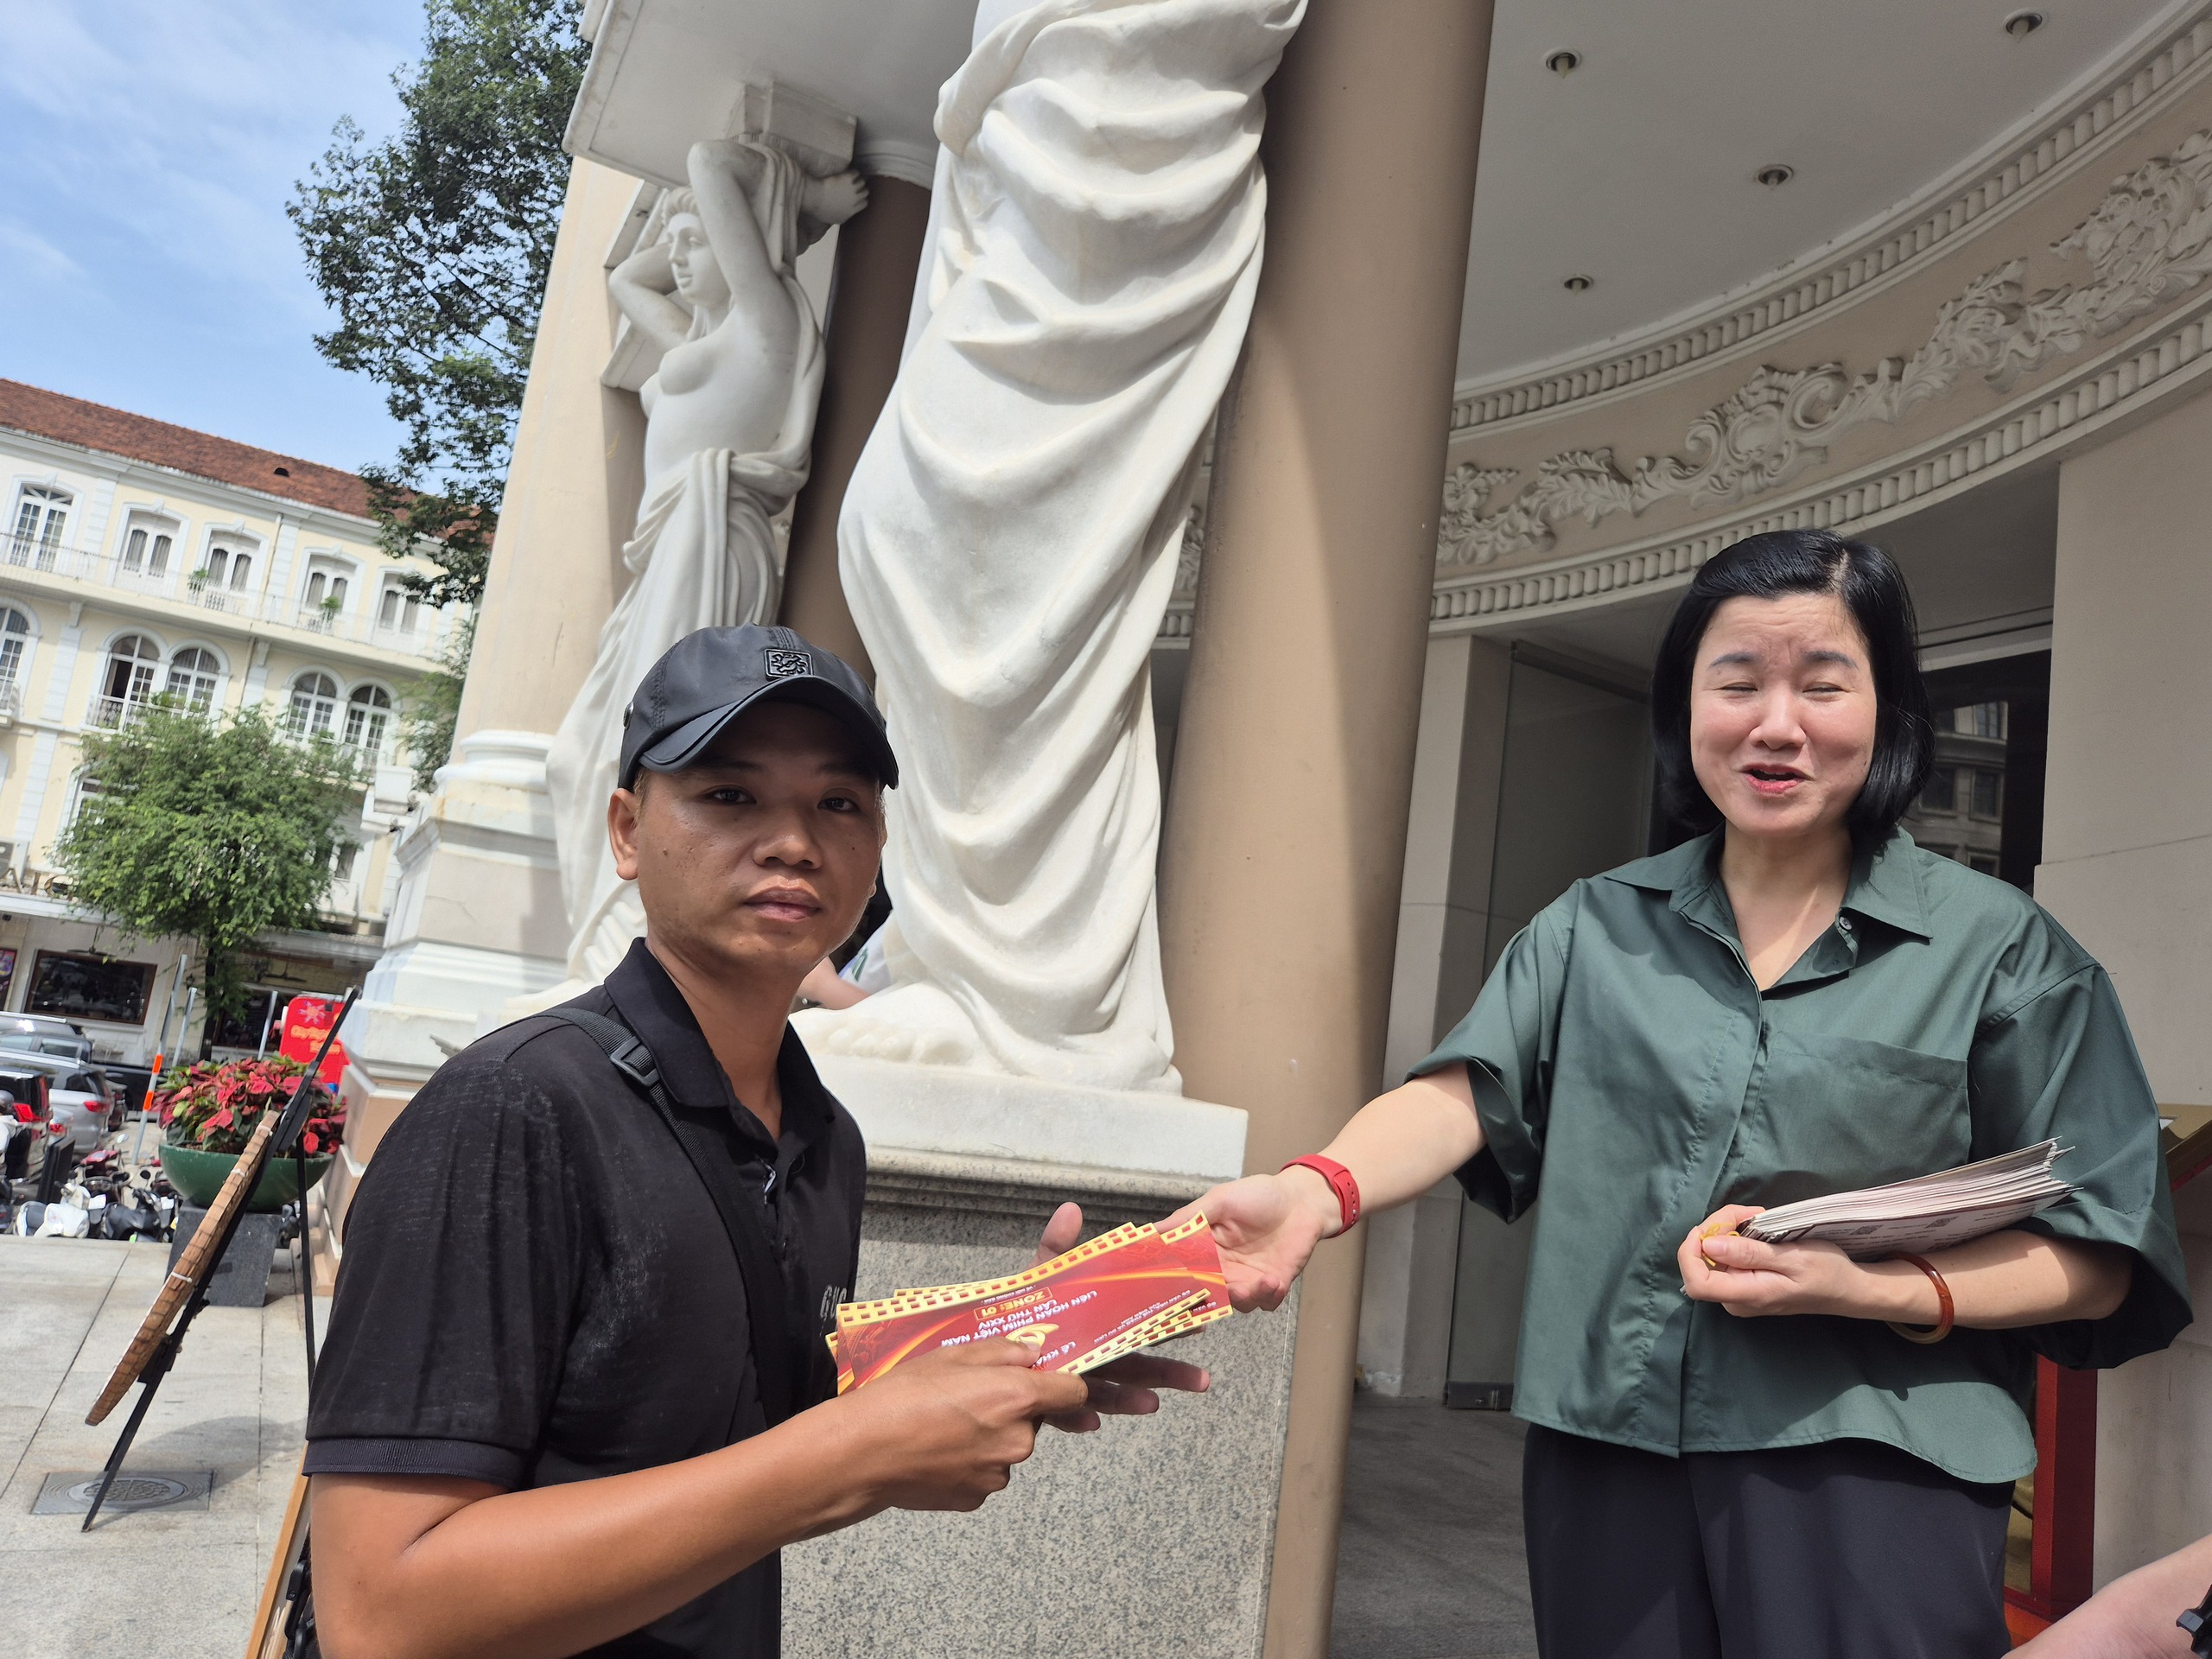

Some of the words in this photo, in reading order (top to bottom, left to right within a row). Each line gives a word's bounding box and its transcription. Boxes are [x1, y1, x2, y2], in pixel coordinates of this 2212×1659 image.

[1071, 1290, 1098, 1307] LIÊN
[981, 1306, 997, 1319] 01
[1002, 1316, 1034, 1332] PHIM
[941, 1333, 971, 1348] NAM
